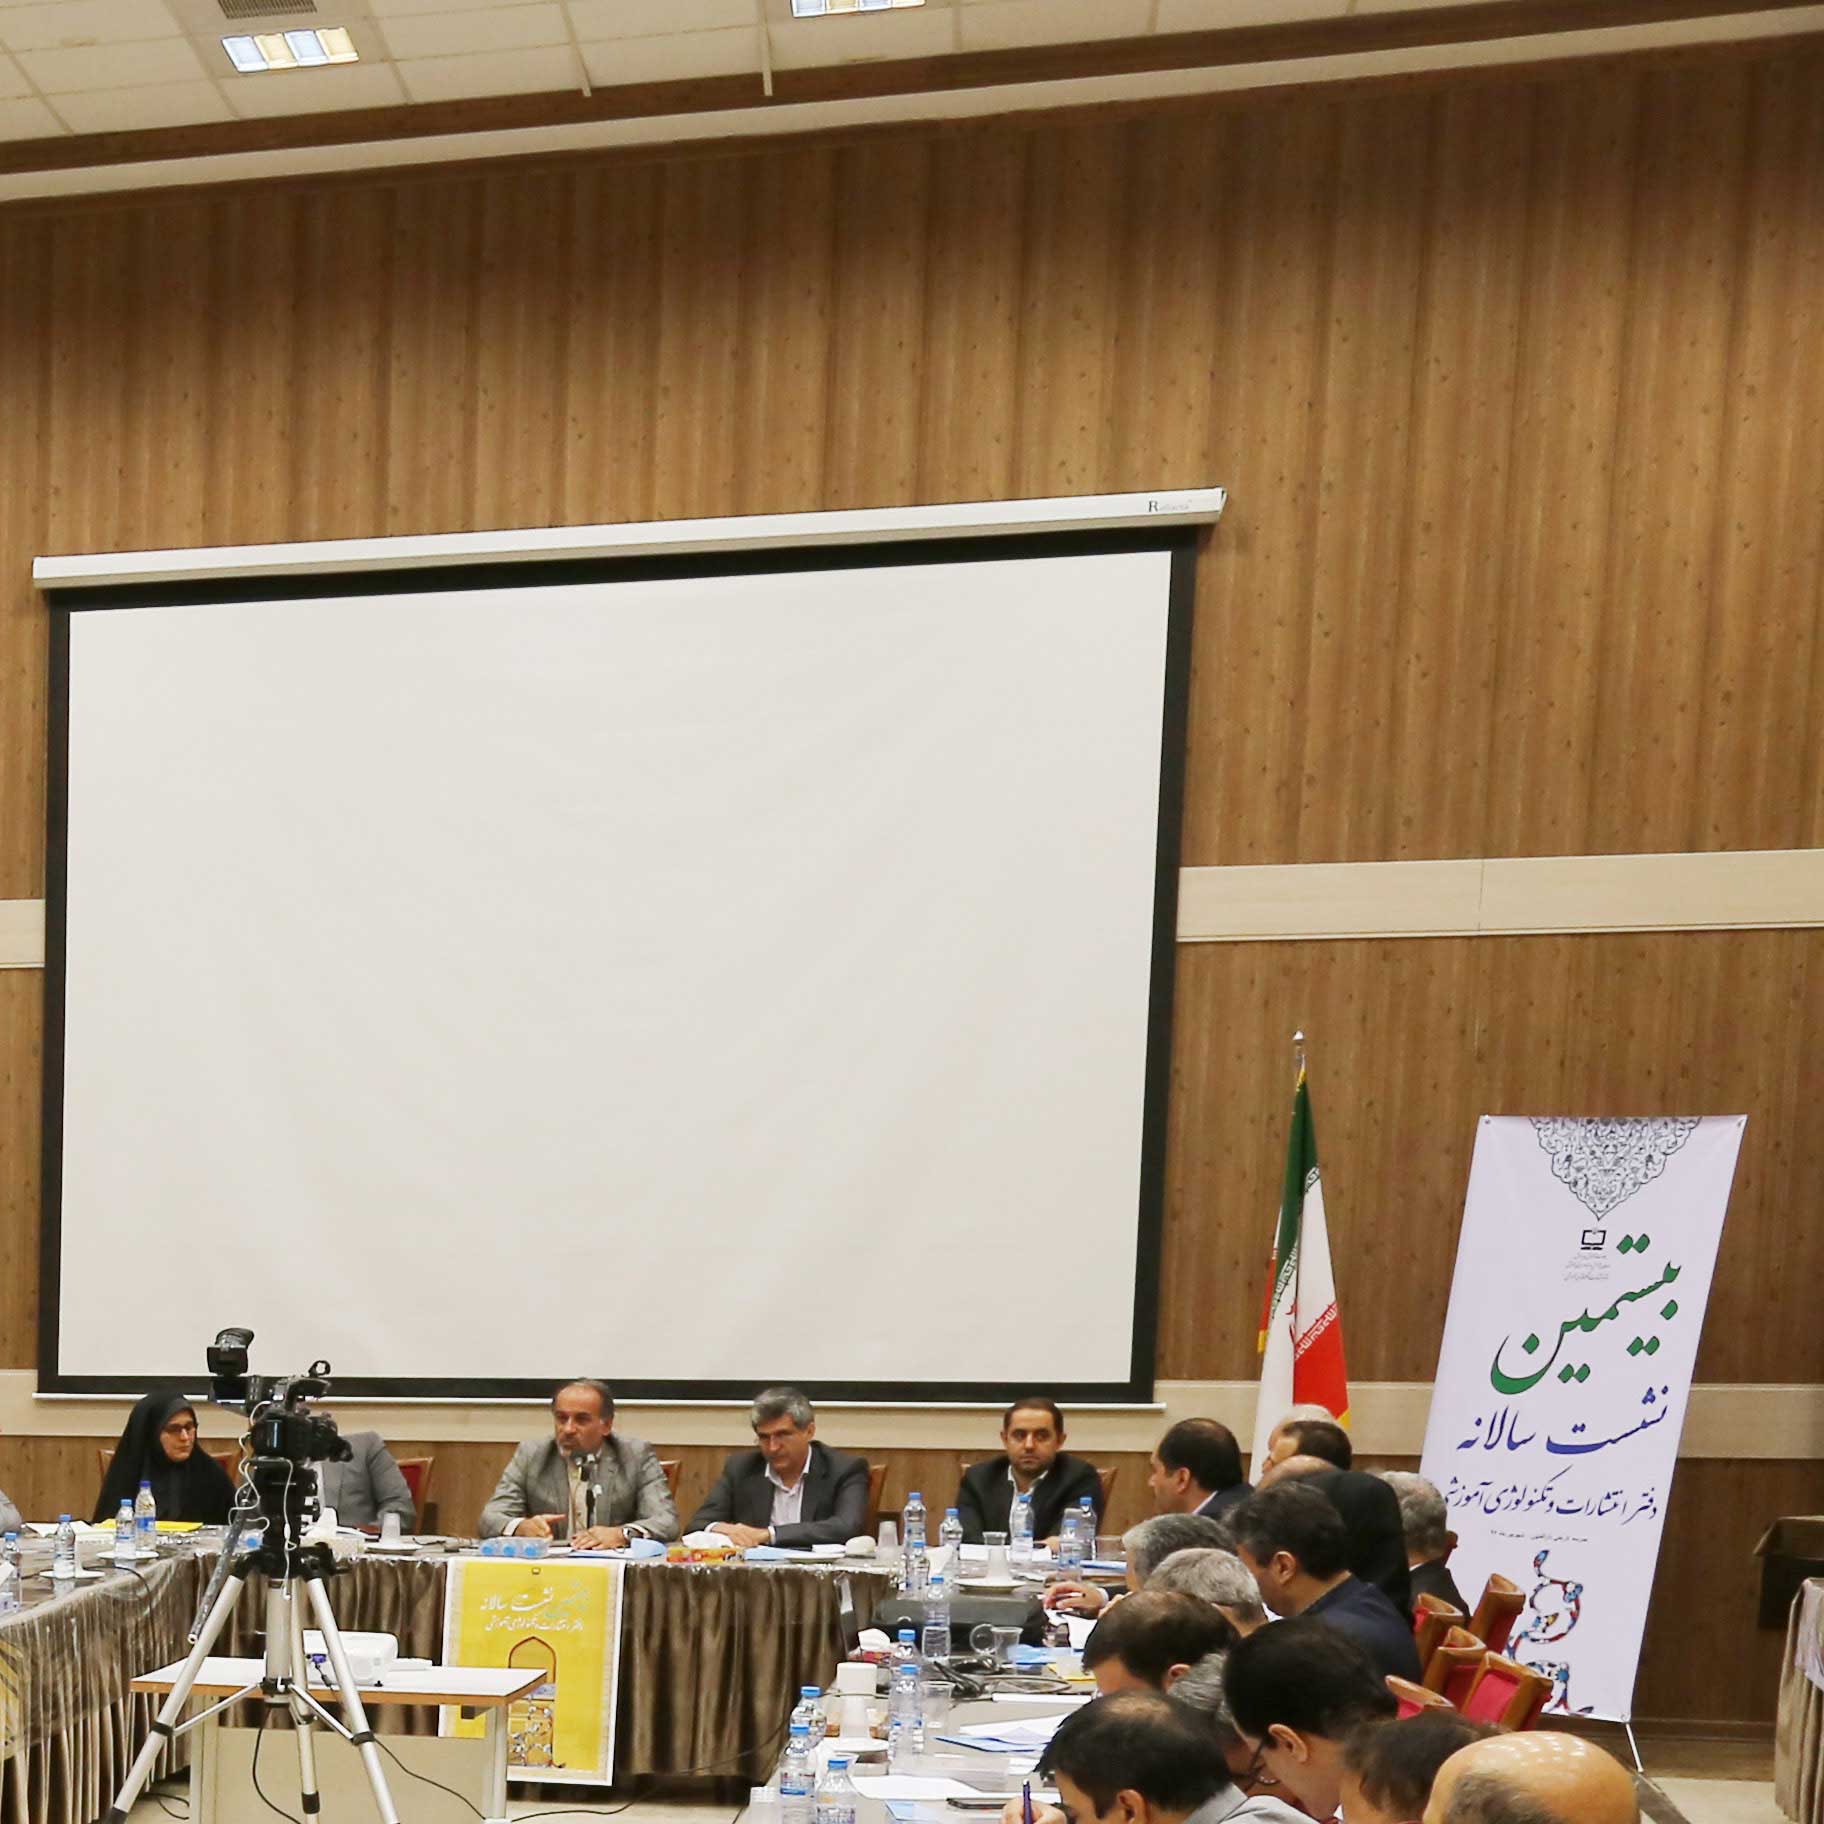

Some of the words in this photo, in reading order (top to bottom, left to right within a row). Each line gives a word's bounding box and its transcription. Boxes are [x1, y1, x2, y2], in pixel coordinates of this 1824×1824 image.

[1490, 1233, 1682, 1395] بیستمین
[1456, 1405, 1536, 1453] سالانه
[1546, 1387, 1670, 1455] نشست
[1444, 1476, 1494, 1507] آموزش
[1556, 1489, 1627, 1516] انتشارات
[1621, 1487, 1657, 1525] دفتر
